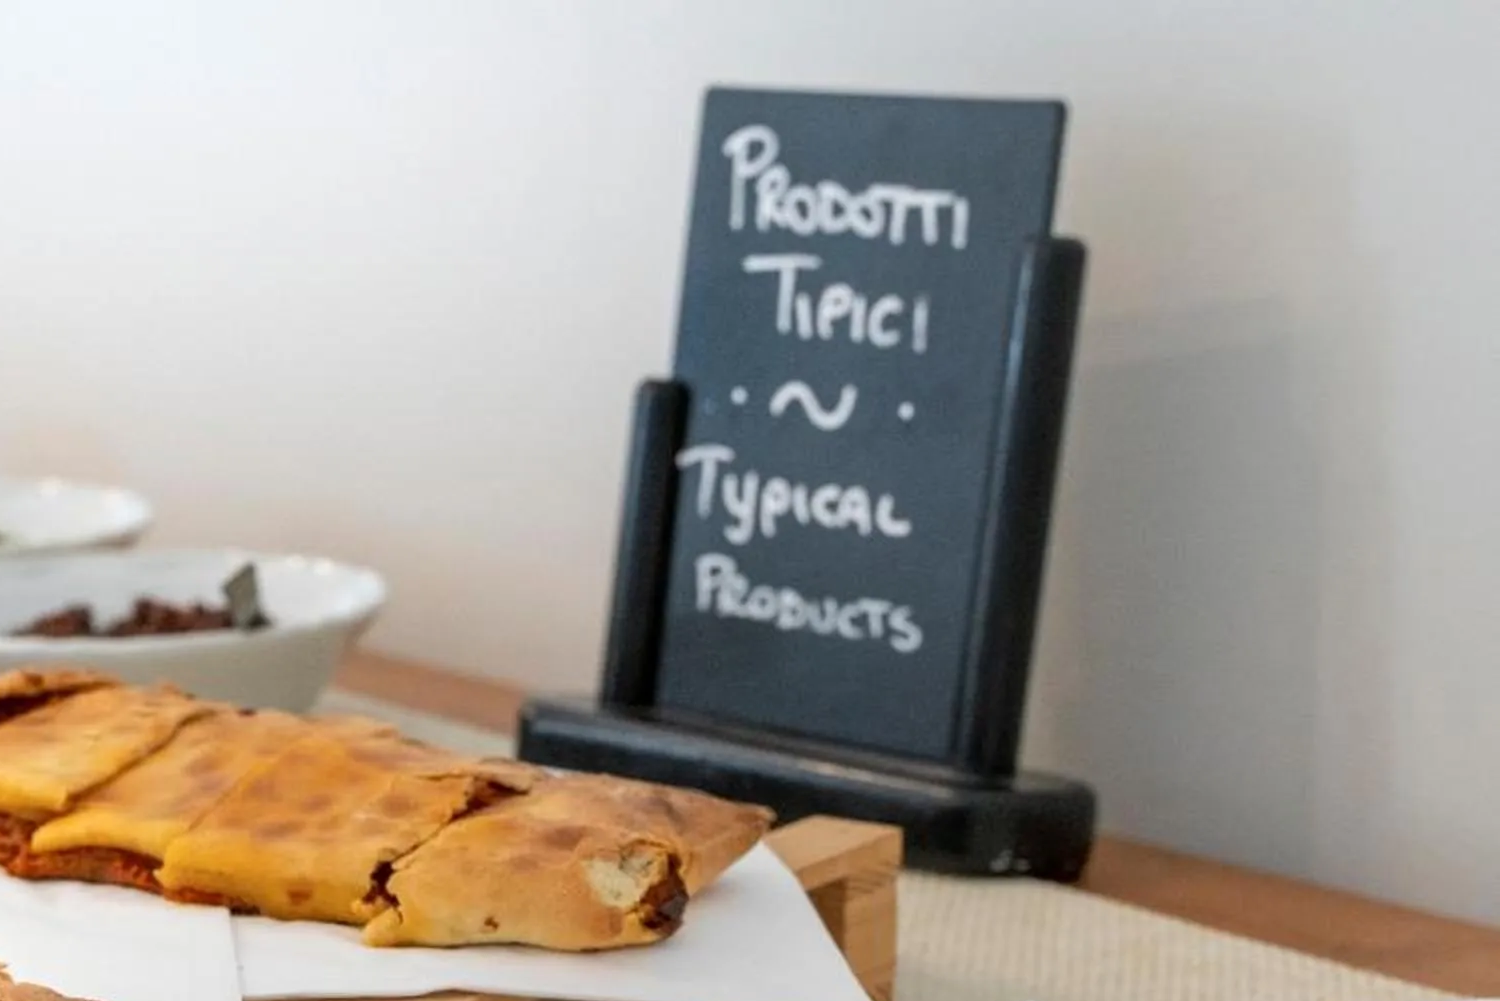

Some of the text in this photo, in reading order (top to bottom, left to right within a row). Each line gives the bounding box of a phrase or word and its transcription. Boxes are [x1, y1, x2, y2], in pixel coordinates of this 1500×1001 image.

[722, 125, 969, 249] PRODOTTI
[742, 253, 929, 353] TIPICI
[677, 444, 912, 545] TYPICAL
[695, 552, 923, 653] PRODUCTS
